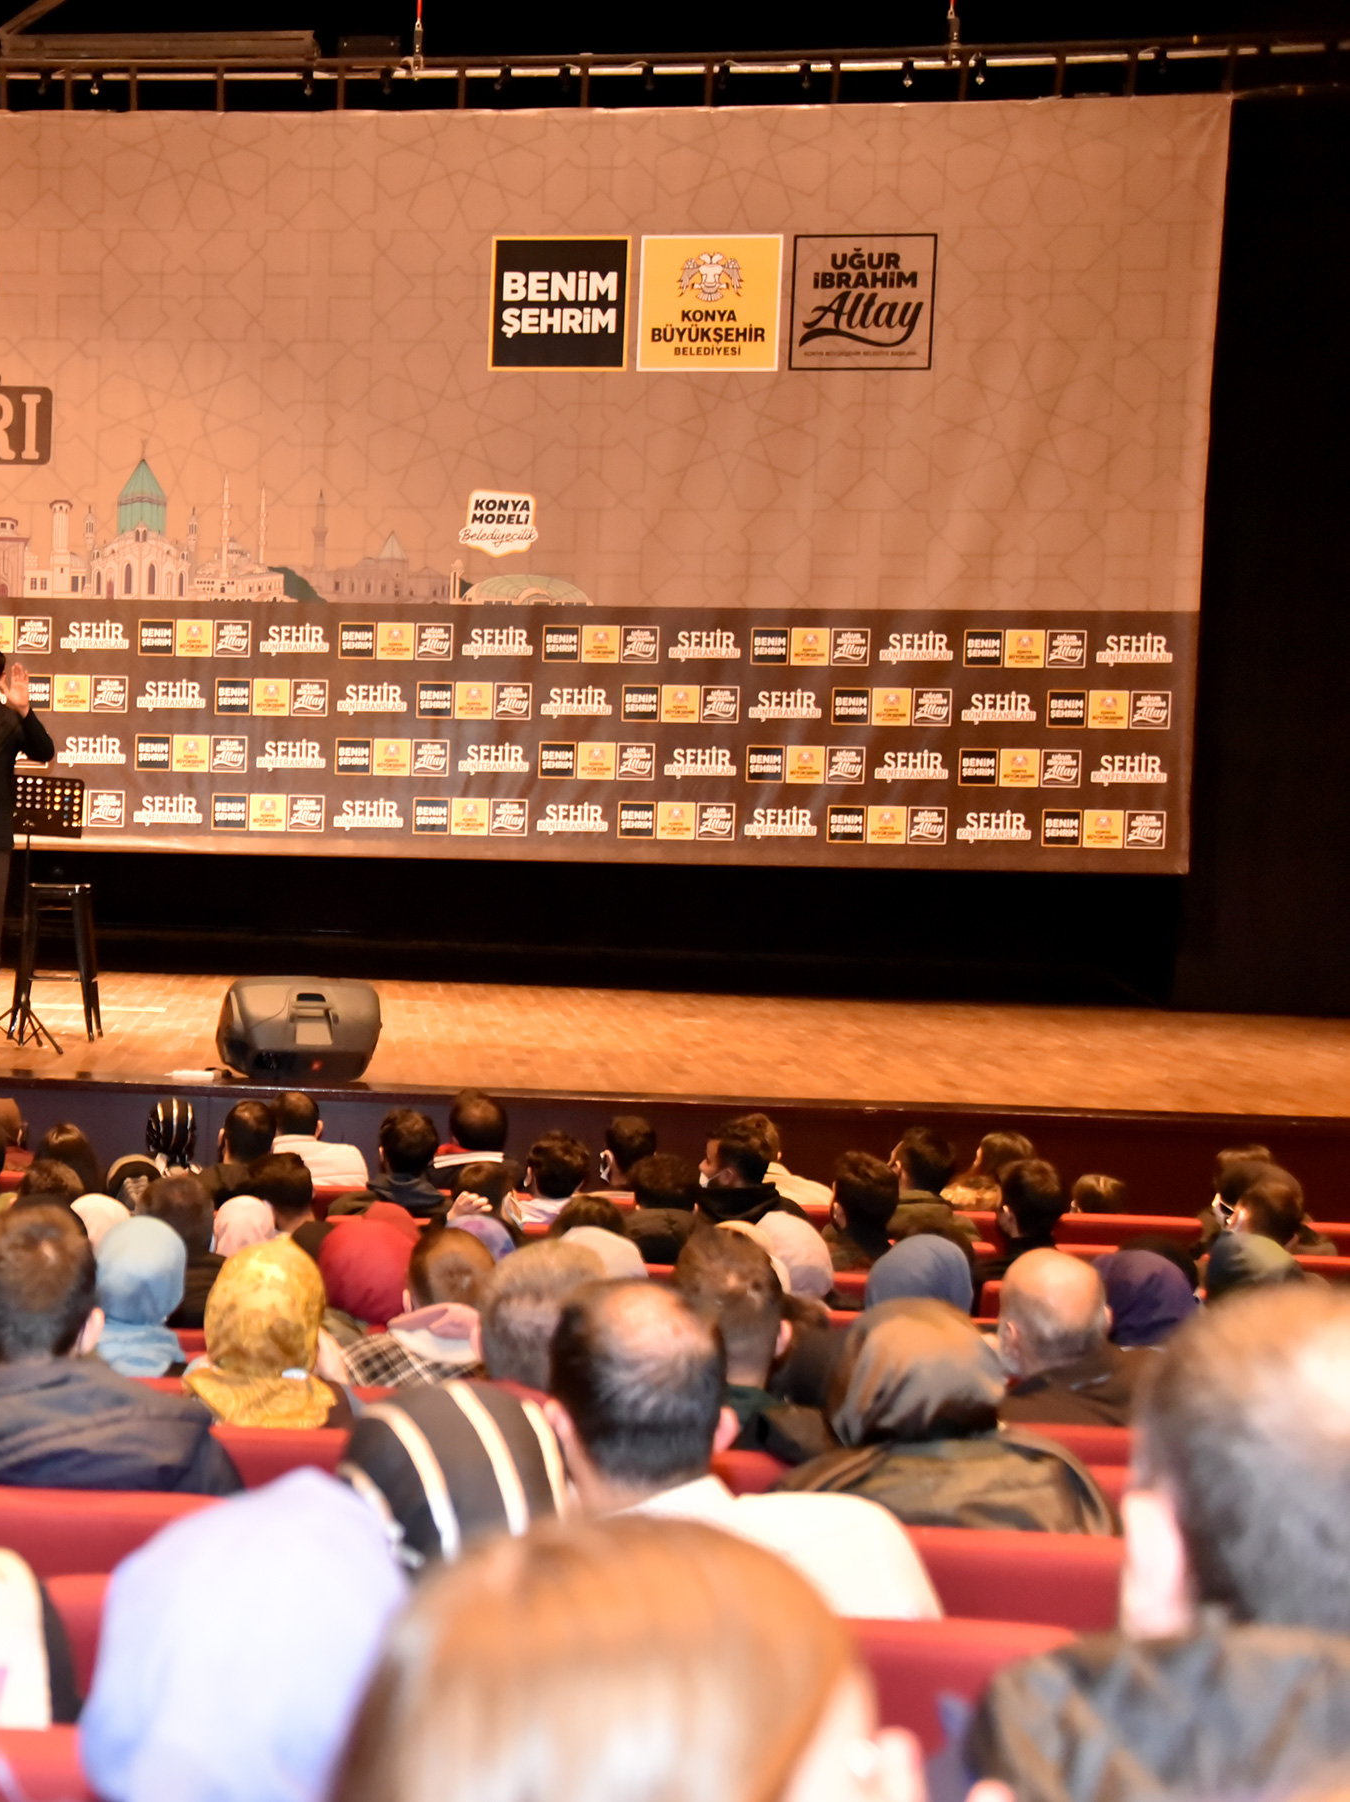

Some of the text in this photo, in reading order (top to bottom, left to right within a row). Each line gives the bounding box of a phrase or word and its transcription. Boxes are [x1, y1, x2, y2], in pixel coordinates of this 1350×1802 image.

[830, 247, 901, 270] UĞUR
[680, 309, 737, 323] KONYA
[798, 289, 925, 347] Altay
[651, 324, 766, 344] BÜYÜKŞEHİR
[673, 345, 742, 357] BELEDİYESİ
[473, 499, 531, 512] KONYA
[461, 528, 534, 548] Belediyecilik
[62, 638, 127, 649] KONFERANSLARI
[261, 642, 327, 653] KONFERANSLARI
[463, 645, 532, 656] KONFERANSLARI
[670, 648, 739, 658] KONFERANSLARI
[881, 650, 952, 661] KONFERANSLARI
[1098, 652, 1171, 663] KONFERANSLARI
[28, 682, 50, 692] ENİM
[138, 698, 204, 708] KONFERANSLARI
[338, 701, 406, 712] KONFERANSLARI
[542, 704, 611, 715] KONFERANSLARI
[750, 708, 820, 718] KONFERANSLARI
[963, 710, 1034, 721] KONFERANSLARI
[59, 754, 124, 764] KONFERANSLARI
[258, 758, 324, 768] KONFERANSLARI
[459, 762, 528, 772] KONFERANSLARI
[665, 765, 735, 776] KONFERANSLARI
[876, 768, 946, 779] KONFERANSLARI
[1092, 772, 1165, 783] KONFERANSLARI
[135, 812, 201, 823] KONFERANSLARI
[335, 816, 401, 827] KONFERANSLARI
[538, 821, 607, 832] KONFERANSLARI
[746, 825, 815, 836] KONFERANSLARI
[958, 829, 1029, 840] KONFERANSLARI
